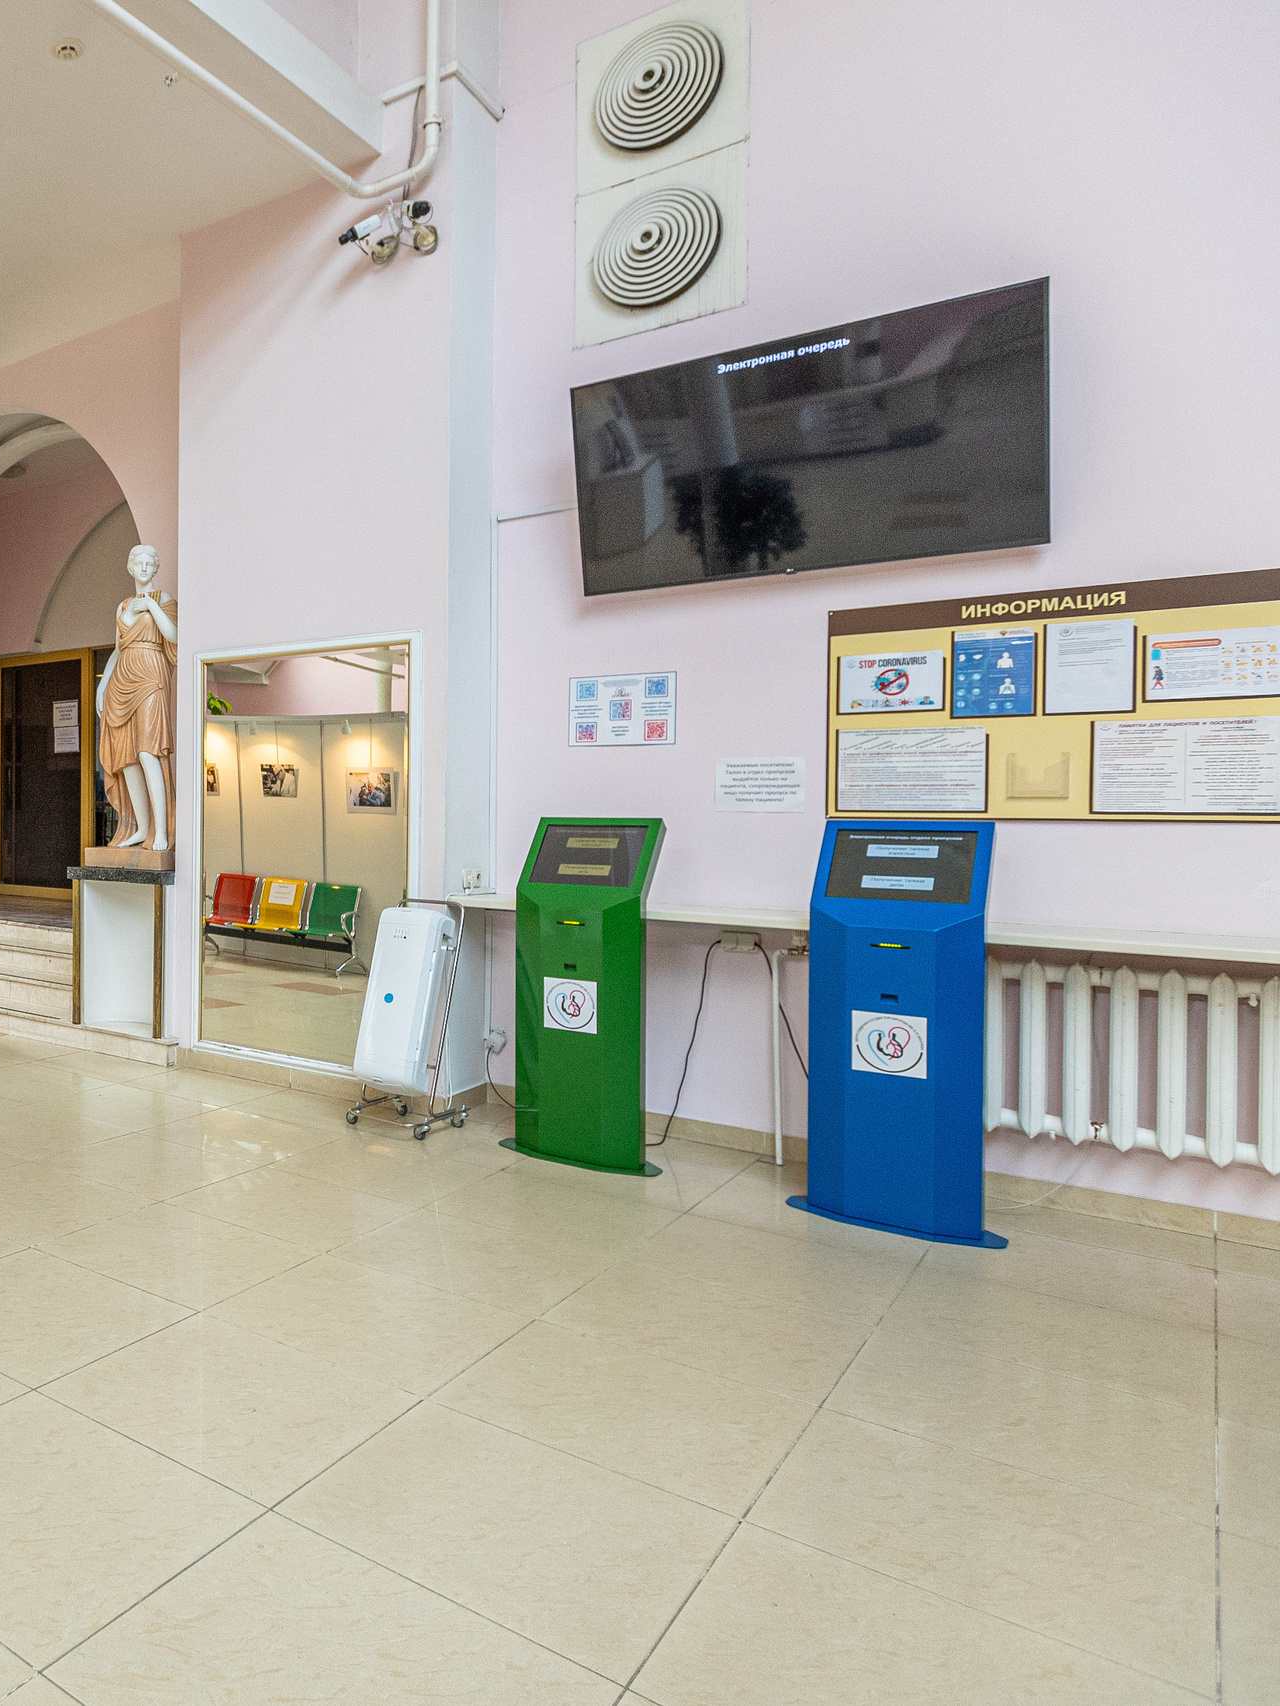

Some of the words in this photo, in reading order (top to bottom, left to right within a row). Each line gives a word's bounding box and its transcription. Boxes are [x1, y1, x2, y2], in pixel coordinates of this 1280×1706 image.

[717, 349, 795, 374] Электронная
[797, 337, 851, 357] очередь
[961, 590, 1127, 619] ИНФОРМАЦИЯ
[859, 660, 877, 669] STOP
[878, 656, 928, 668] CORONAVIRUS
